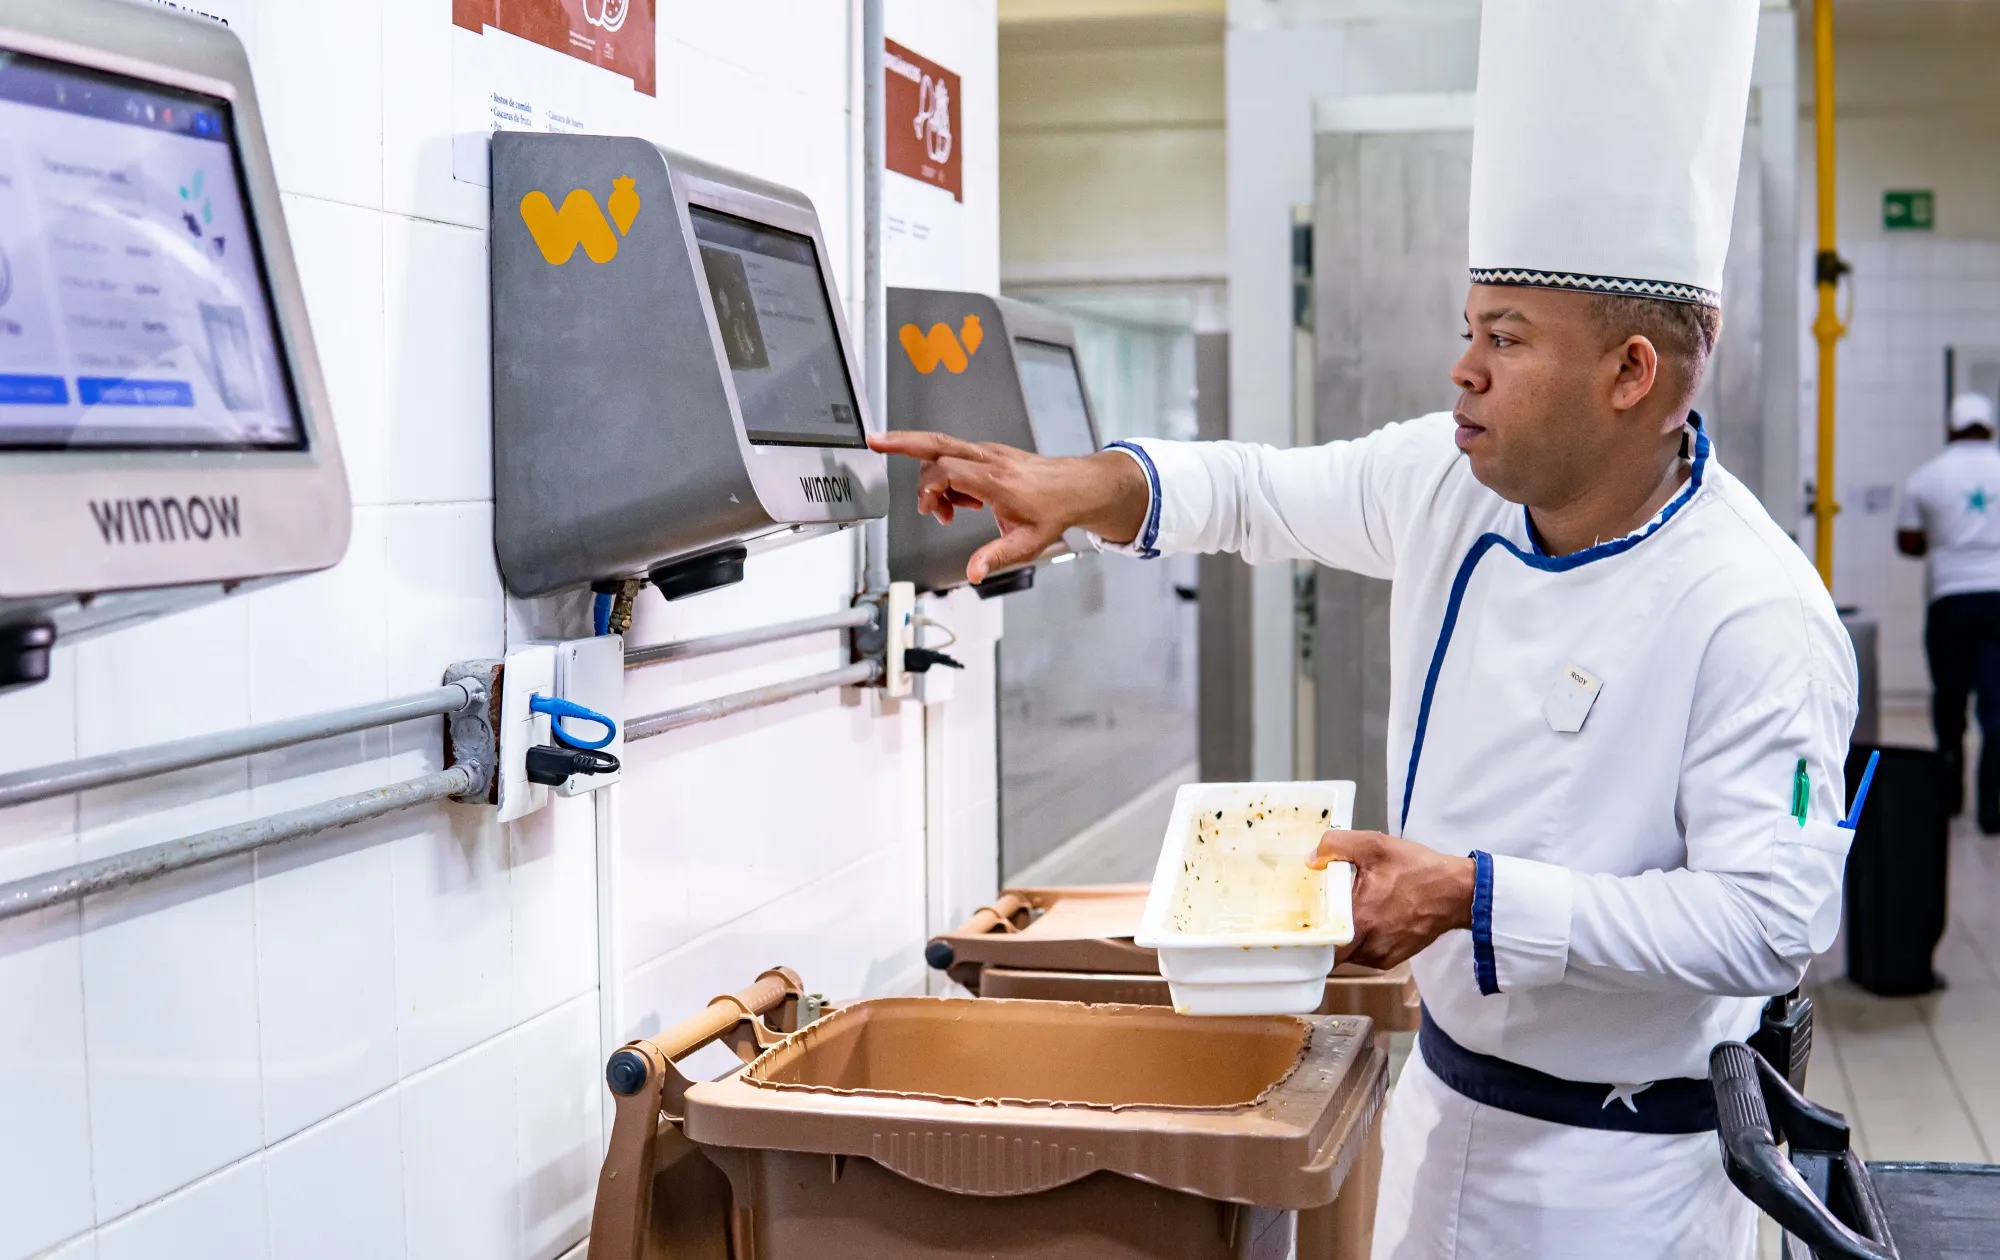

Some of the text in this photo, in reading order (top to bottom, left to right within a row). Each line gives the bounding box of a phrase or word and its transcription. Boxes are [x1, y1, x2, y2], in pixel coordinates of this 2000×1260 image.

[494, 92, 508, 106] Restos
[515, 101, 532, 113] comida
[799, 476, 852, 503] winnow
[88, 495, 241, 545] winnow
